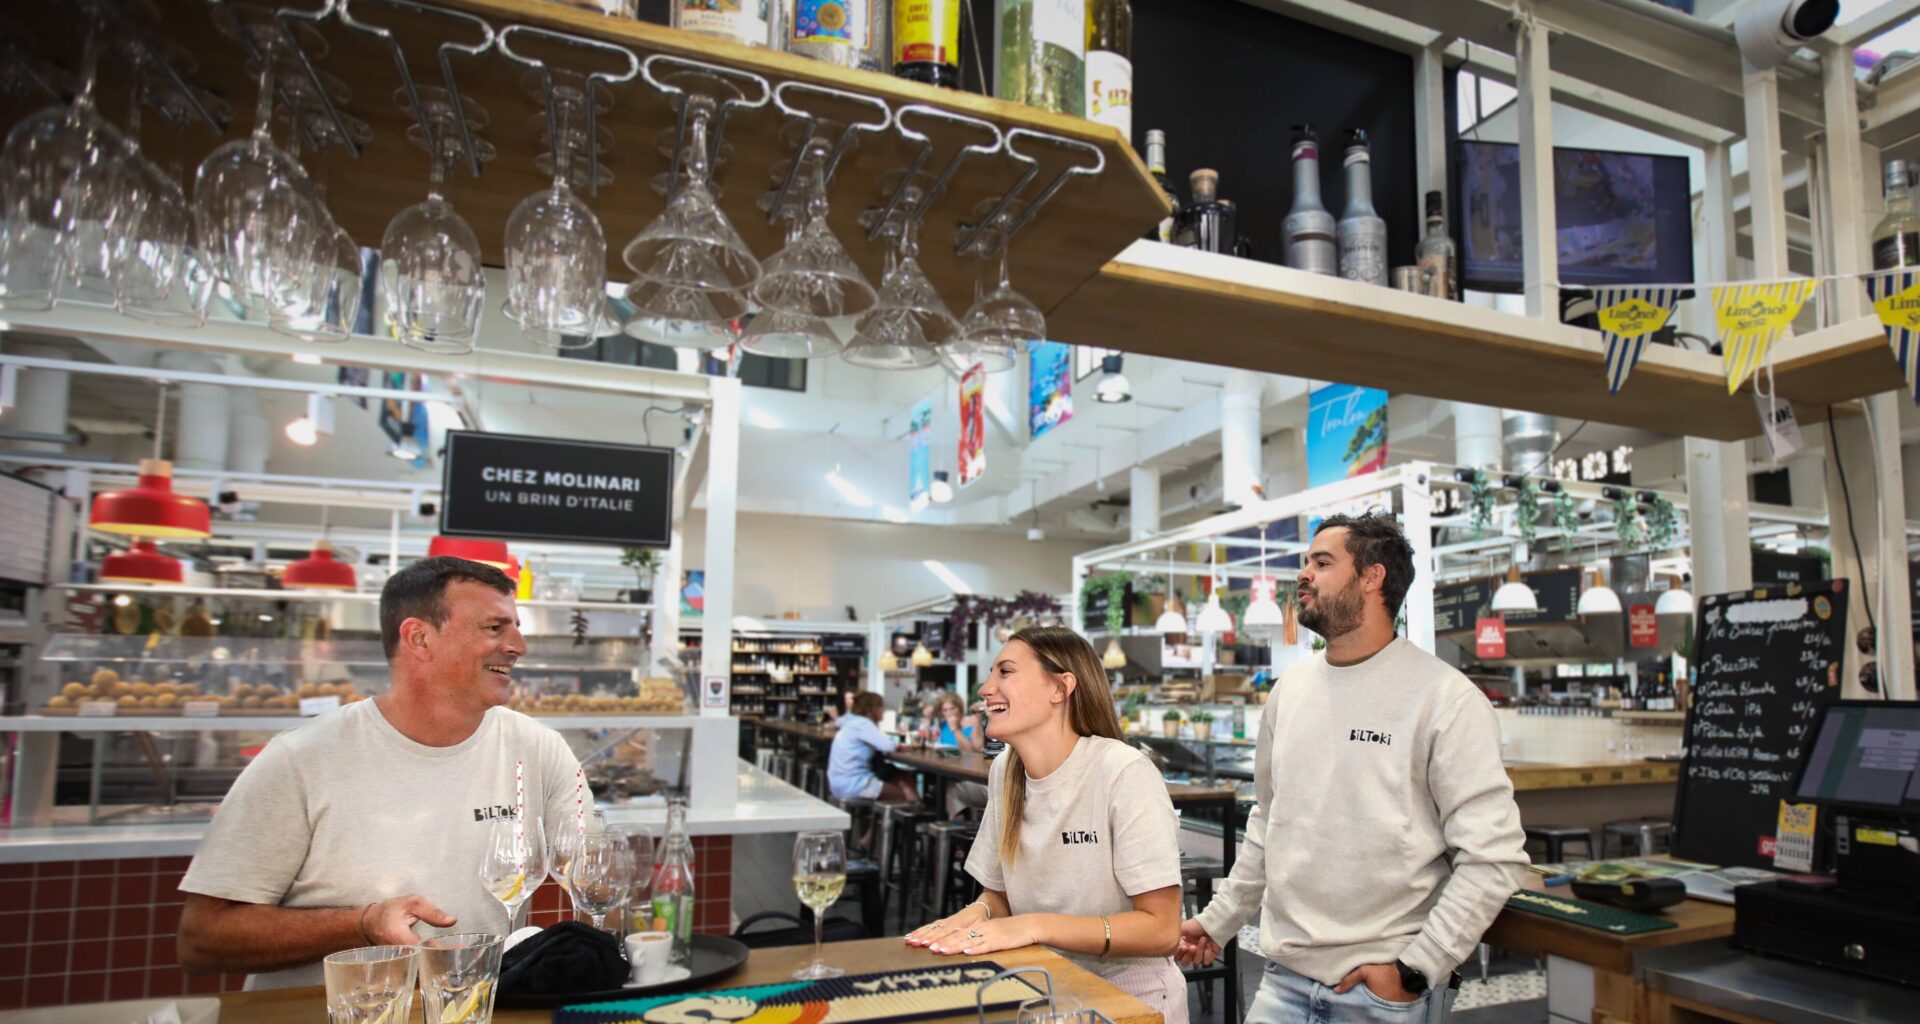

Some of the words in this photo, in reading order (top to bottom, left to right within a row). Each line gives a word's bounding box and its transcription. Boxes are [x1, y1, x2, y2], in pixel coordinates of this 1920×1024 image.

[482, 466, 538, 485] CHEZ
[544, 471, 641, 492] MOLINARI
[485, 490, 512, 503] UN
[517, 491, 560, 506] BRIN
[566, 495, 634, 511] D'ITALIE
